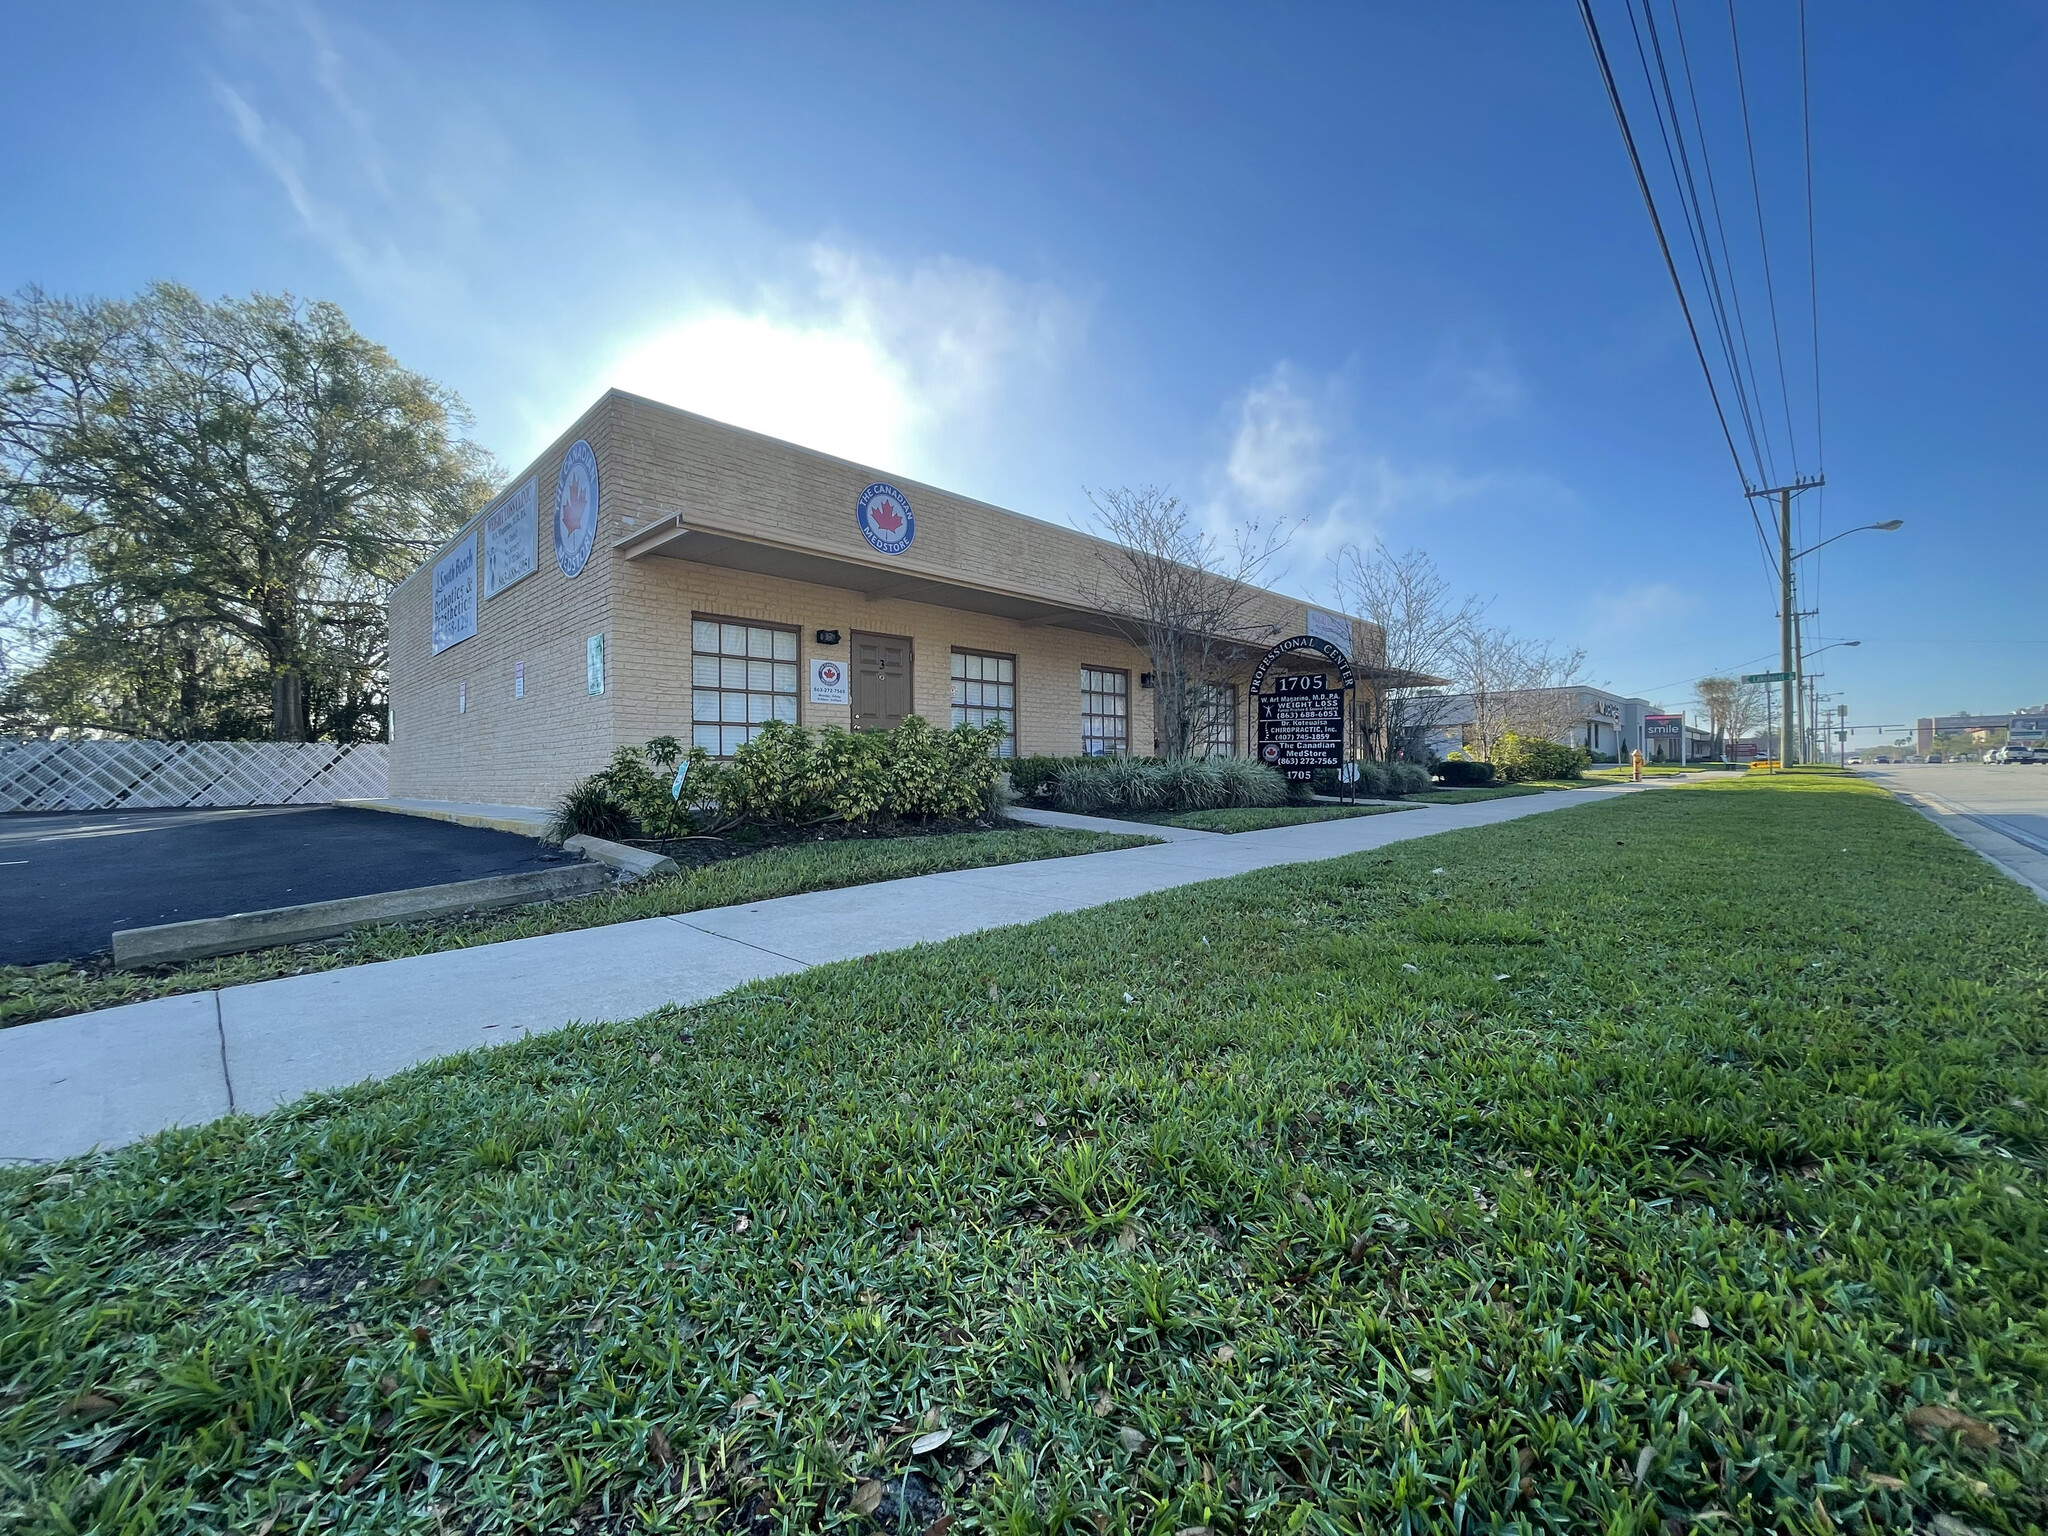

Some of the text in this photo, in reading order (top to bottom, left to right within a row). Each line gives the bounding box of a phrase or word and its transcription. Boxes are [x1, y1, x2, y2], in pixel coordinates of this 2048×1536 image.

[555, 446, 596, 511] THE CANADIAN
[860, 485, 913, 520] THE CANADIAN
[558, 525, 594, 572] MEDSTORE
[864, 526, 910, 552] MEDSTORE
[456, 548, 474, 579] Beach
[434, 577, 473, 616] Orthotics &
[434, 596, 472, 628] Prosthetics
[879, 659, 885, 670] 3
[1250, 638, 1354, 693] PROFESSIONAL CENTER
[1279, 675, 1322, 691] 1705
[1648, 725, 1679, 734] smile
[1287, 771, 1311, 780] 1705
